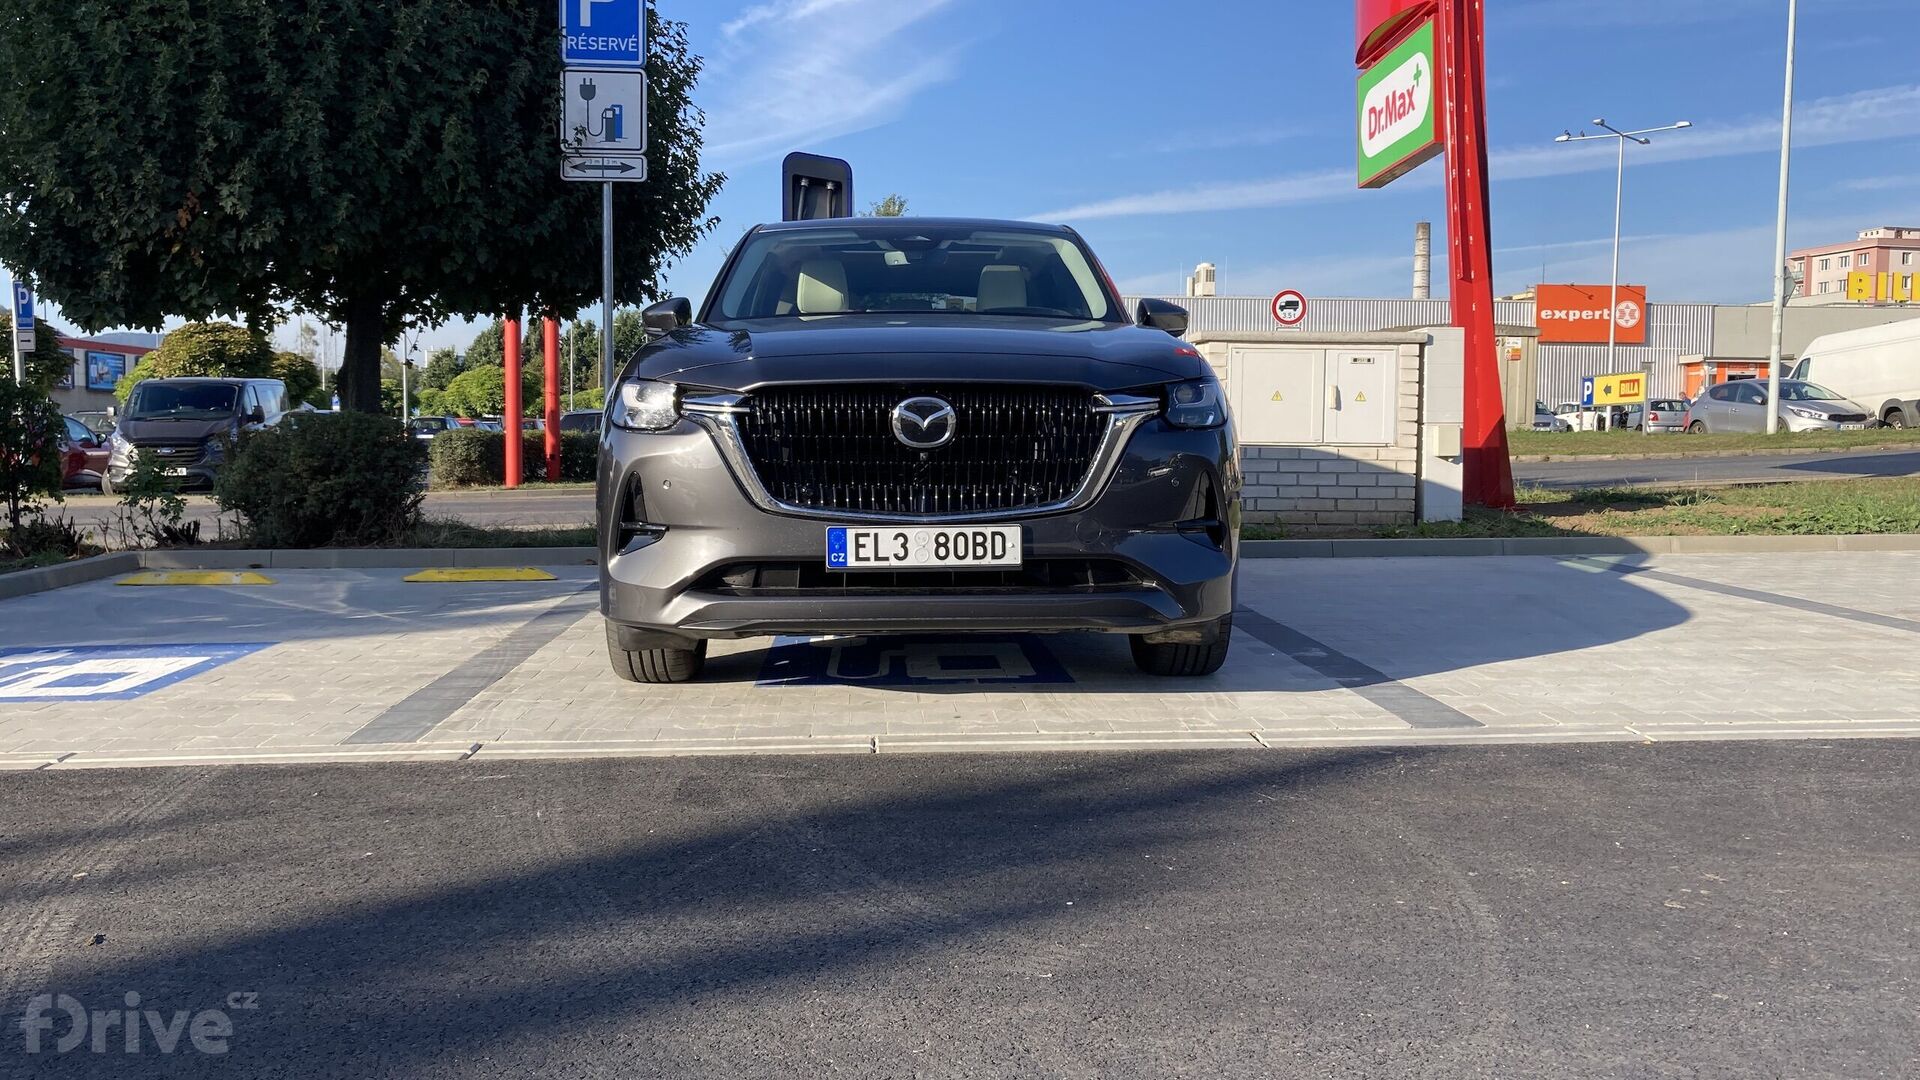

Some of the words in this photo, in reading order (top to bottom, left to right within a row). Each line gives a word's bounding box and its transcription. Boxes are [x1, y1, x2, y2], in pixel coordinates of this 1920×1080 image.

[567, 32, 638, 52] RÉSERVÉ
[1368, 84, 1416, 141] Dr.Max
[18, 287, 29, 315] P
[1540, 308, 1611, 322] expert
[1584, 381, 1593, 402] P
[1620, 381, 1640, 396] BILLA
[854, 532, 909, 562] EL3
[934, 531, 1006, 561] 80BD
[831, 553, 845, 562] CZ
